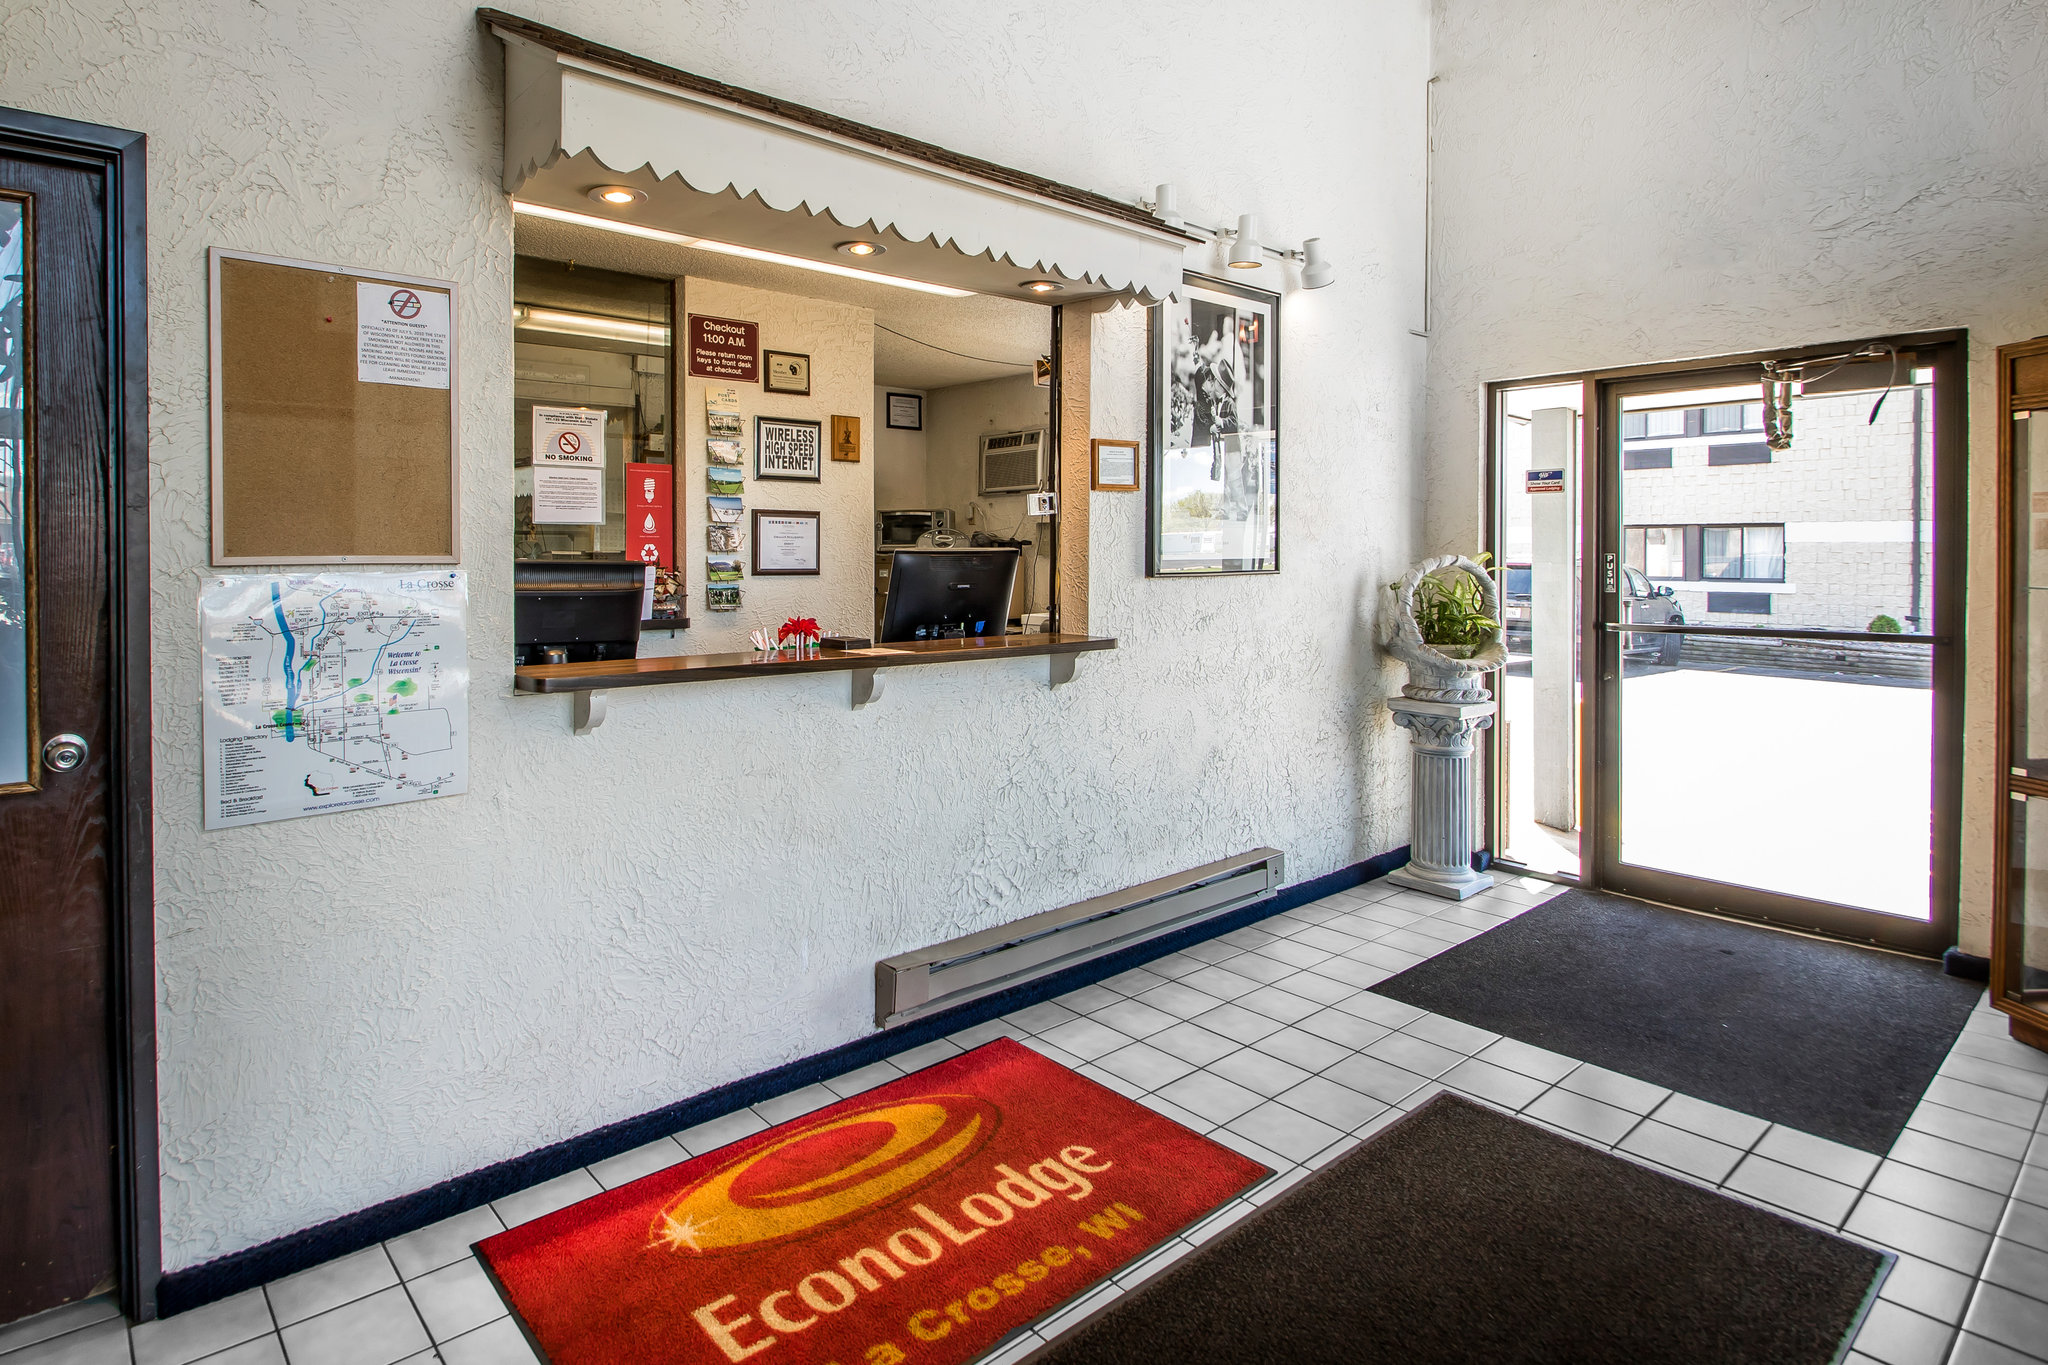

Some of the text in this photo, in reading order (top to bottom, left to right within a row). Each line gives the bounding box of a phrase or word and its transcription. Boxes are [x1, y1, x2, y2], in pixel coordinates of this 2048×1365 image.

[703, 321, 745, 335] Checkout
[703, 333, 725, 345] 11:00
[696, 349, 716, 357] Please
[697, 357, 713, 366] keys
[722, 359, 736, 367] front
[714, 366, 742, 375] checkout.
[765, 426, 814, 443] WIRELESS
[765, 441, 814, 457] HIGH SPEED
[558, 454, 593, 462] SMOKING
[765, 455, 814, 471] INTERNET
[400, 579, 454, 589] La Crosse
[388, 666, 422, 675] Wisconsin!
[302, 797, 380, 812] www.explorelacrosse.com
[691, 1143, 1114, 1364] EconoLodge
[907, 1243, 1094, 1343] Crosse,
[1078, 1200, 1147, 1242] WI
